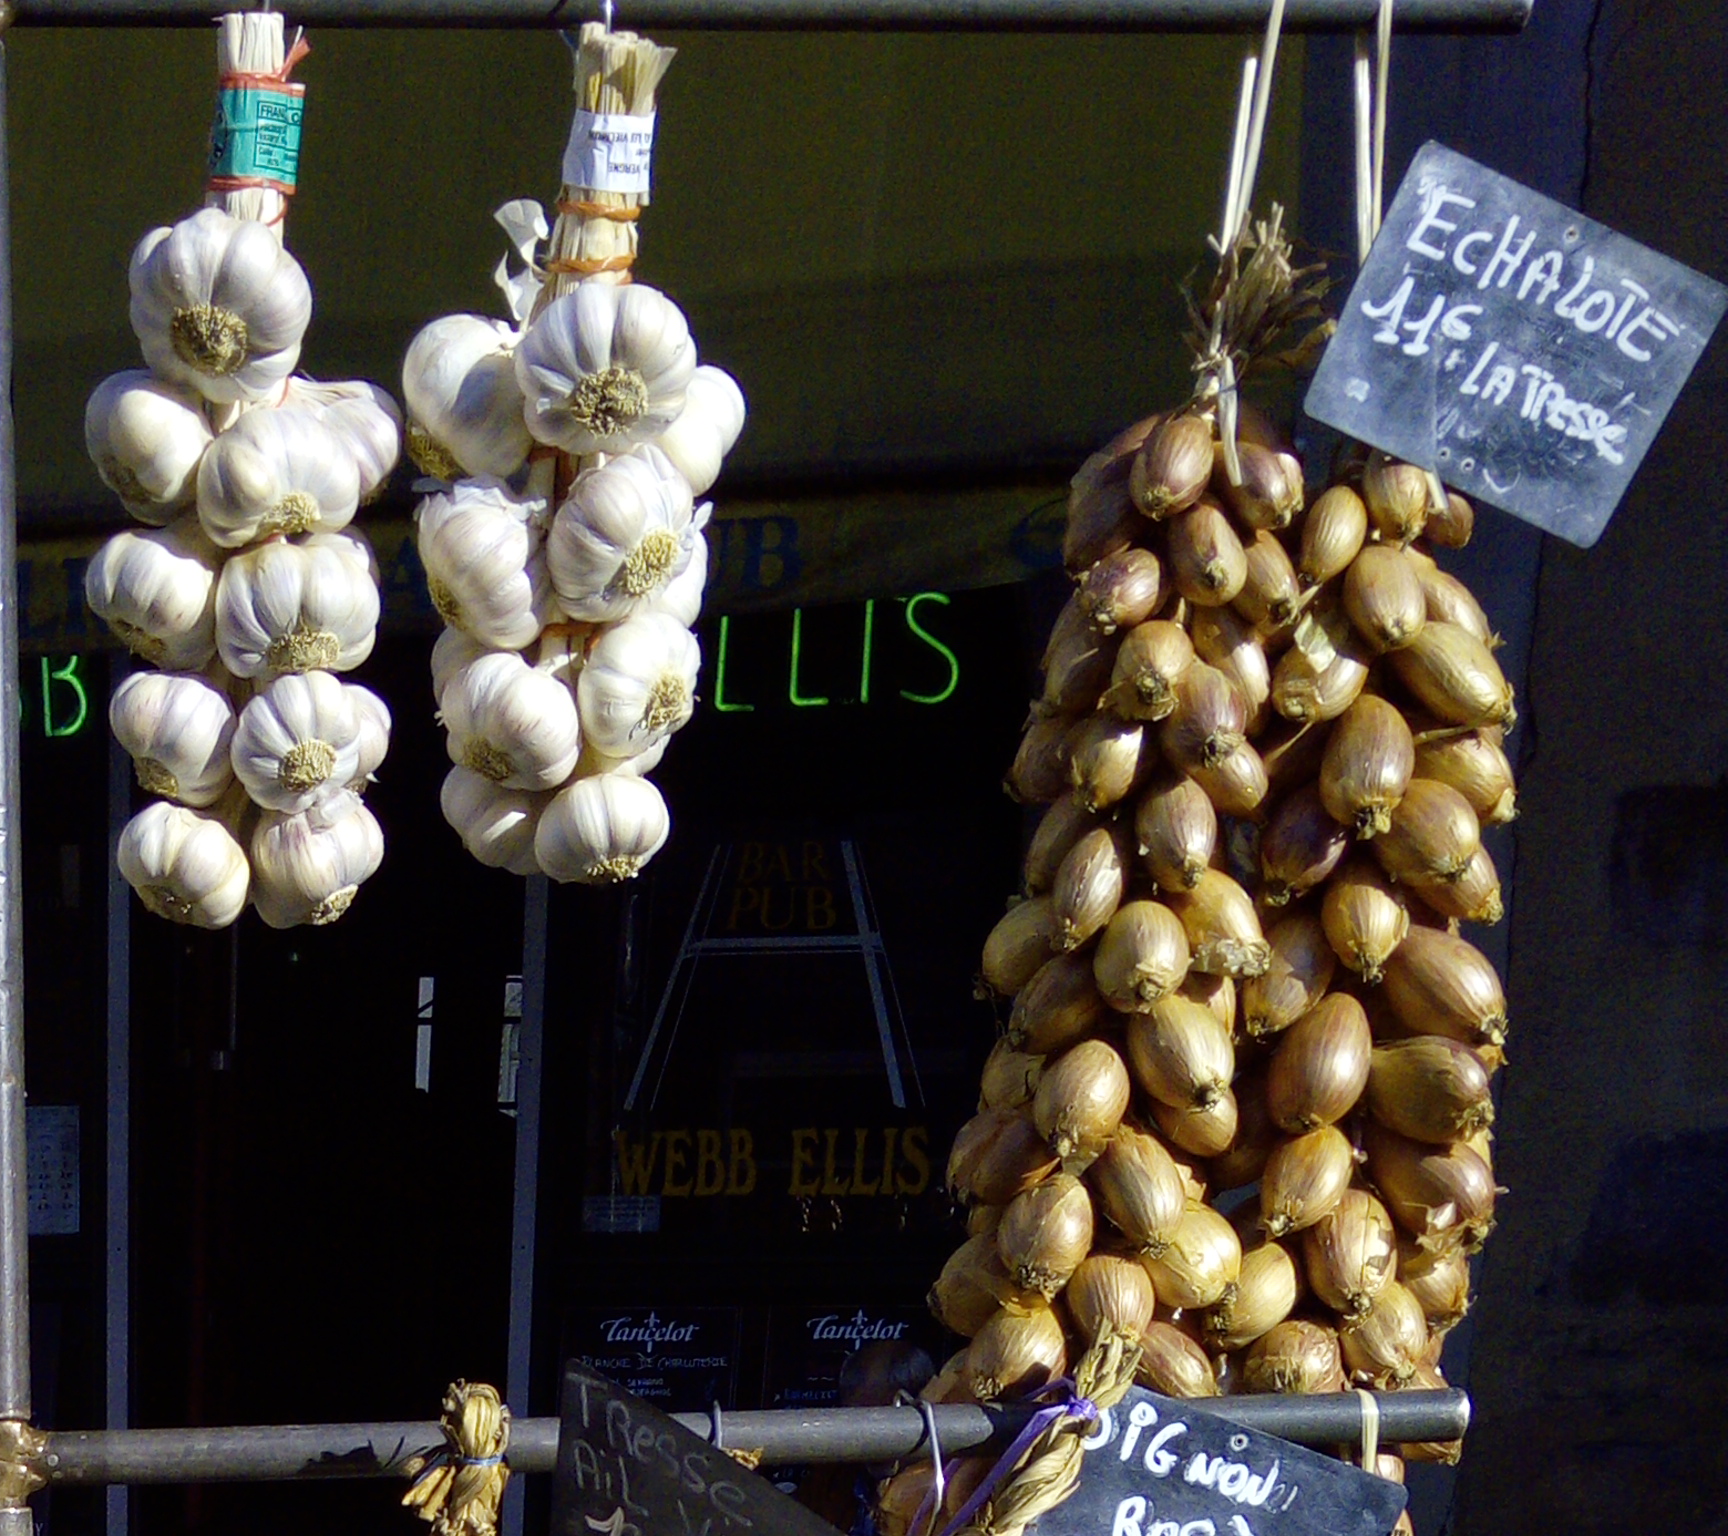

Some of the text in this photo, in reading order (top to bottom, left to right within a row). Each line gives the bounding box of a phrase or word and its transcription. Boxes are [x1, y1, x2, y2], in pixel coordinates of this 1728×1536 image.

[713, 591, 961, 713] LLIS
[737, 842, 833, 882] BAR
[727, 886, 837, 931] PUB
[616, 1126, 932, 1197] WEBB ELLIS
